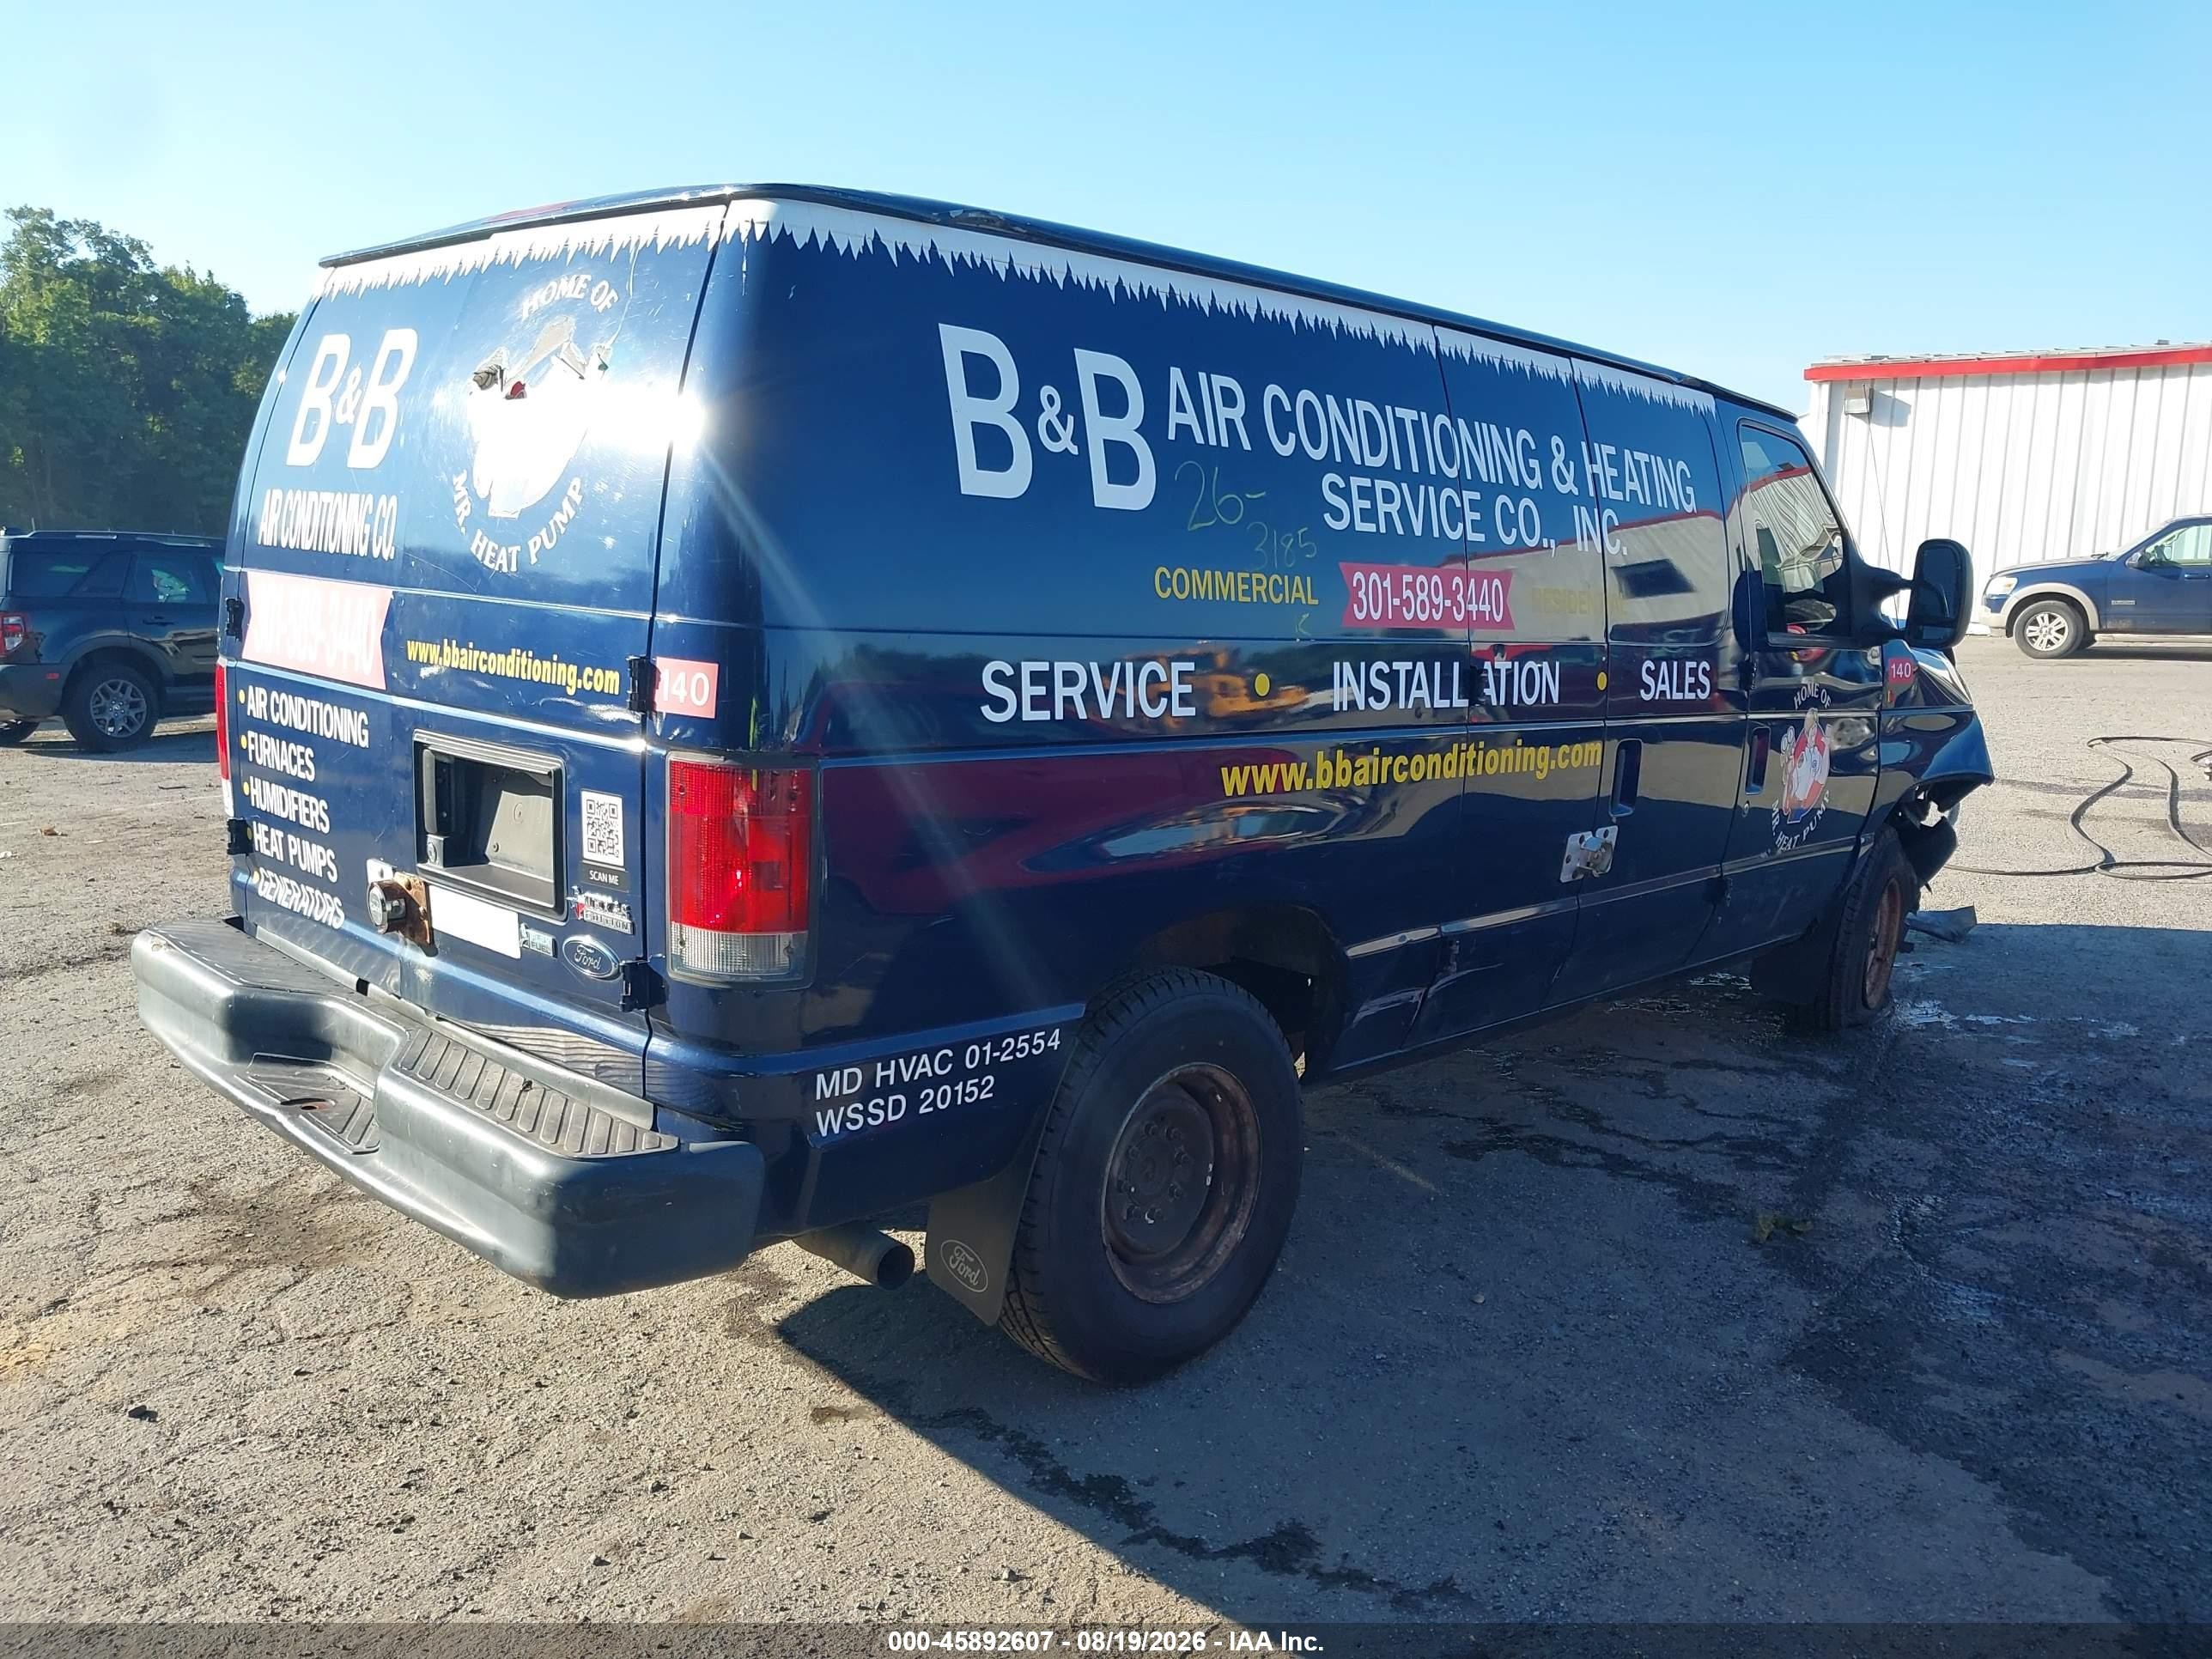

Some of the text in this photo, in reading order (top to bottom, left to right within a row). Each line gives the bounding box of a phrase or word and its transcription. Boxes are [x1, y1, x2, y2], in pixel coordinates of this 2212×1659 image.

[522, 274, 618, 321] HOME OF
[286, 328, 418, 469] B&B
[938, 323, 1158, 511] B&B
[1168, 366, 1697, 514] AIR CONDITIONING & HEATING
[258, 489, 398, 561] AIR CONDITIONING CO.
[453, 470, 585, 574] MR. HEAT PUMP
[1321, 473, 1628, 557] SERVICE CO., INC.
[1154, 566, 1319, 605] COMMERCIAL
[1352, 571, 1504, 623] 301-589-3440
[254, 581, 377, 676] 1-589-3440
[406, 637, 620, 696] www.bbairconditioning.com
[660, 669, 710, 708] 140
[981, 659, 1196, 723] SERVICE
[1640, 659, 1711, 702] SALES
[1794, 682, 1832, 709] HOME OF
[1891, 662, 1911, 678] 140
[247, 684, 369, 749] AIR CONDITIONING
[247, 730, 316, 782] FURNACES
[1220, 738, 1604, 797] www.bbairconditioning.com
[249, 775, 331, 835] HUMIDIFIERS
[1771, 789, 1831, 852] MR. HEAT PUMP
[252, 821, 338, 884] HEAT PUMPS
[589, 869, 619, 885] SCAN ME
[258, 866, 345, 930] GENERATORS
[574, 944, 602, 970] Ford
[815, 1028, 1061, 1100] MD HVAC 01-2554
[816, 1075, 995, 1138] WSSD 20152
[949, 1245, 981, 1286] Ford
